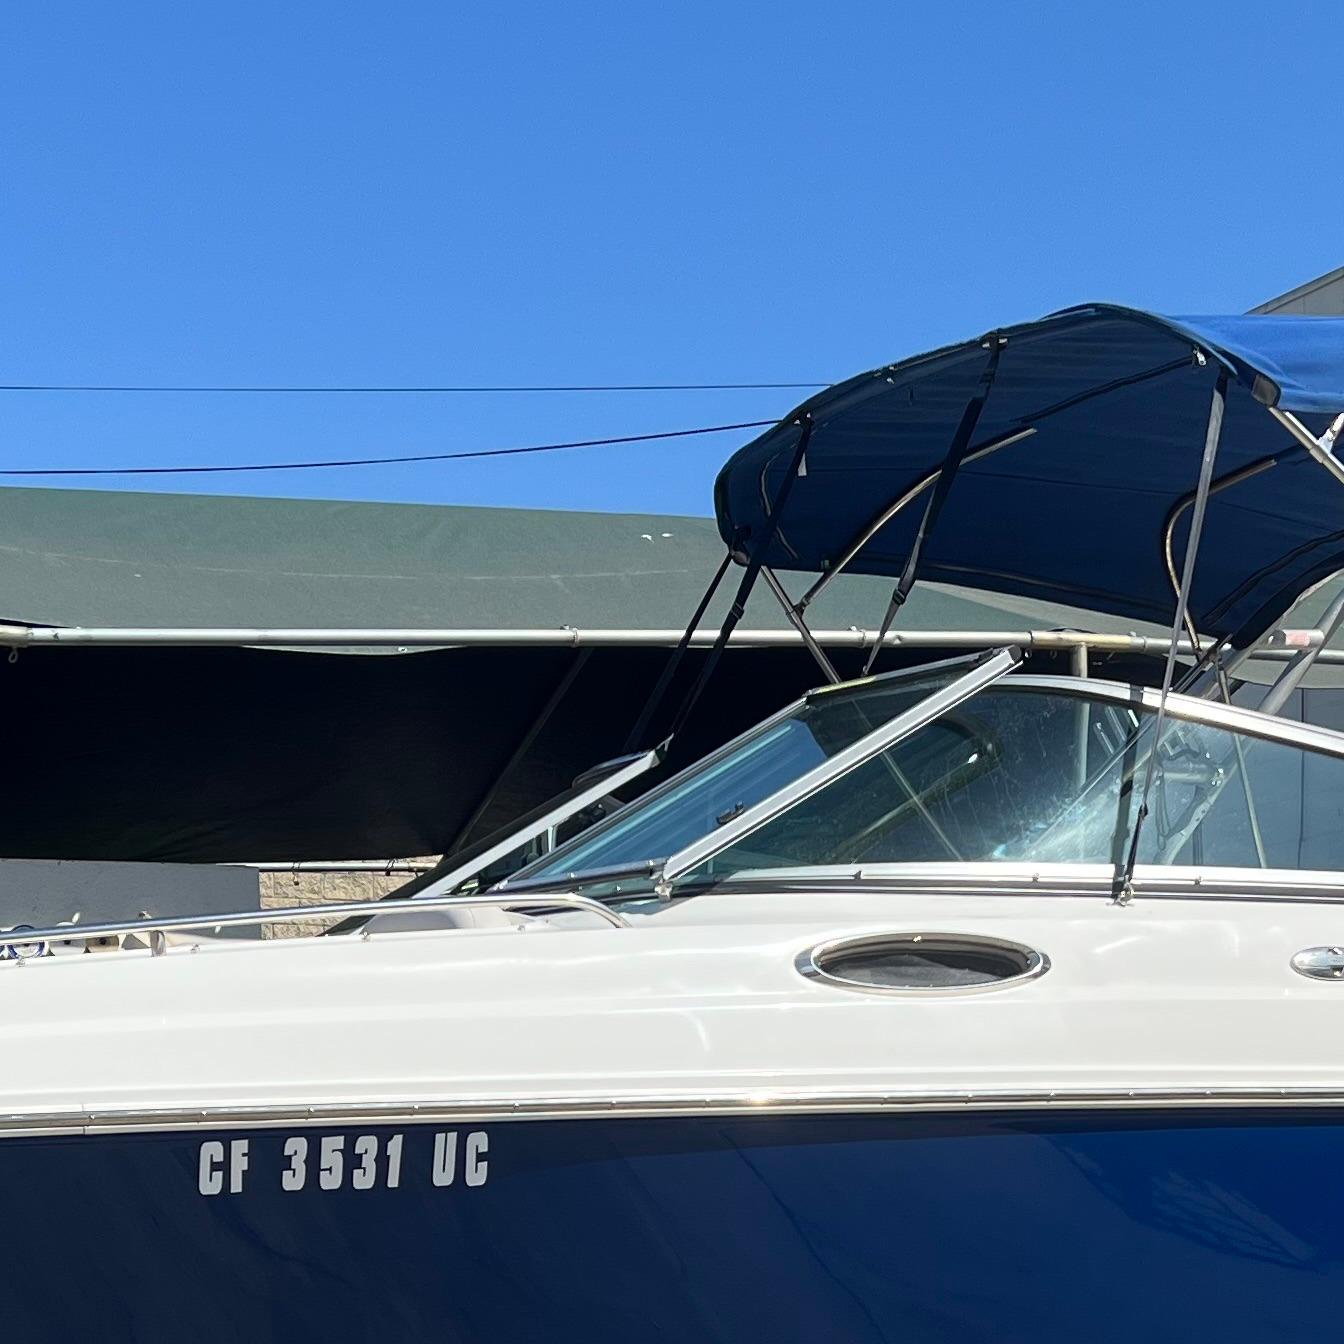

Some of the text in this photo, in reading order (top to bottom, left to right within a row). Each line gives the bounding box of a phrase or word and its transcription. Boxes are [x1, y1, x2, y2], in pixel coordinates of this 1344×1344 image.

[198, 1131, 489, 1196] CF 3531 UC
